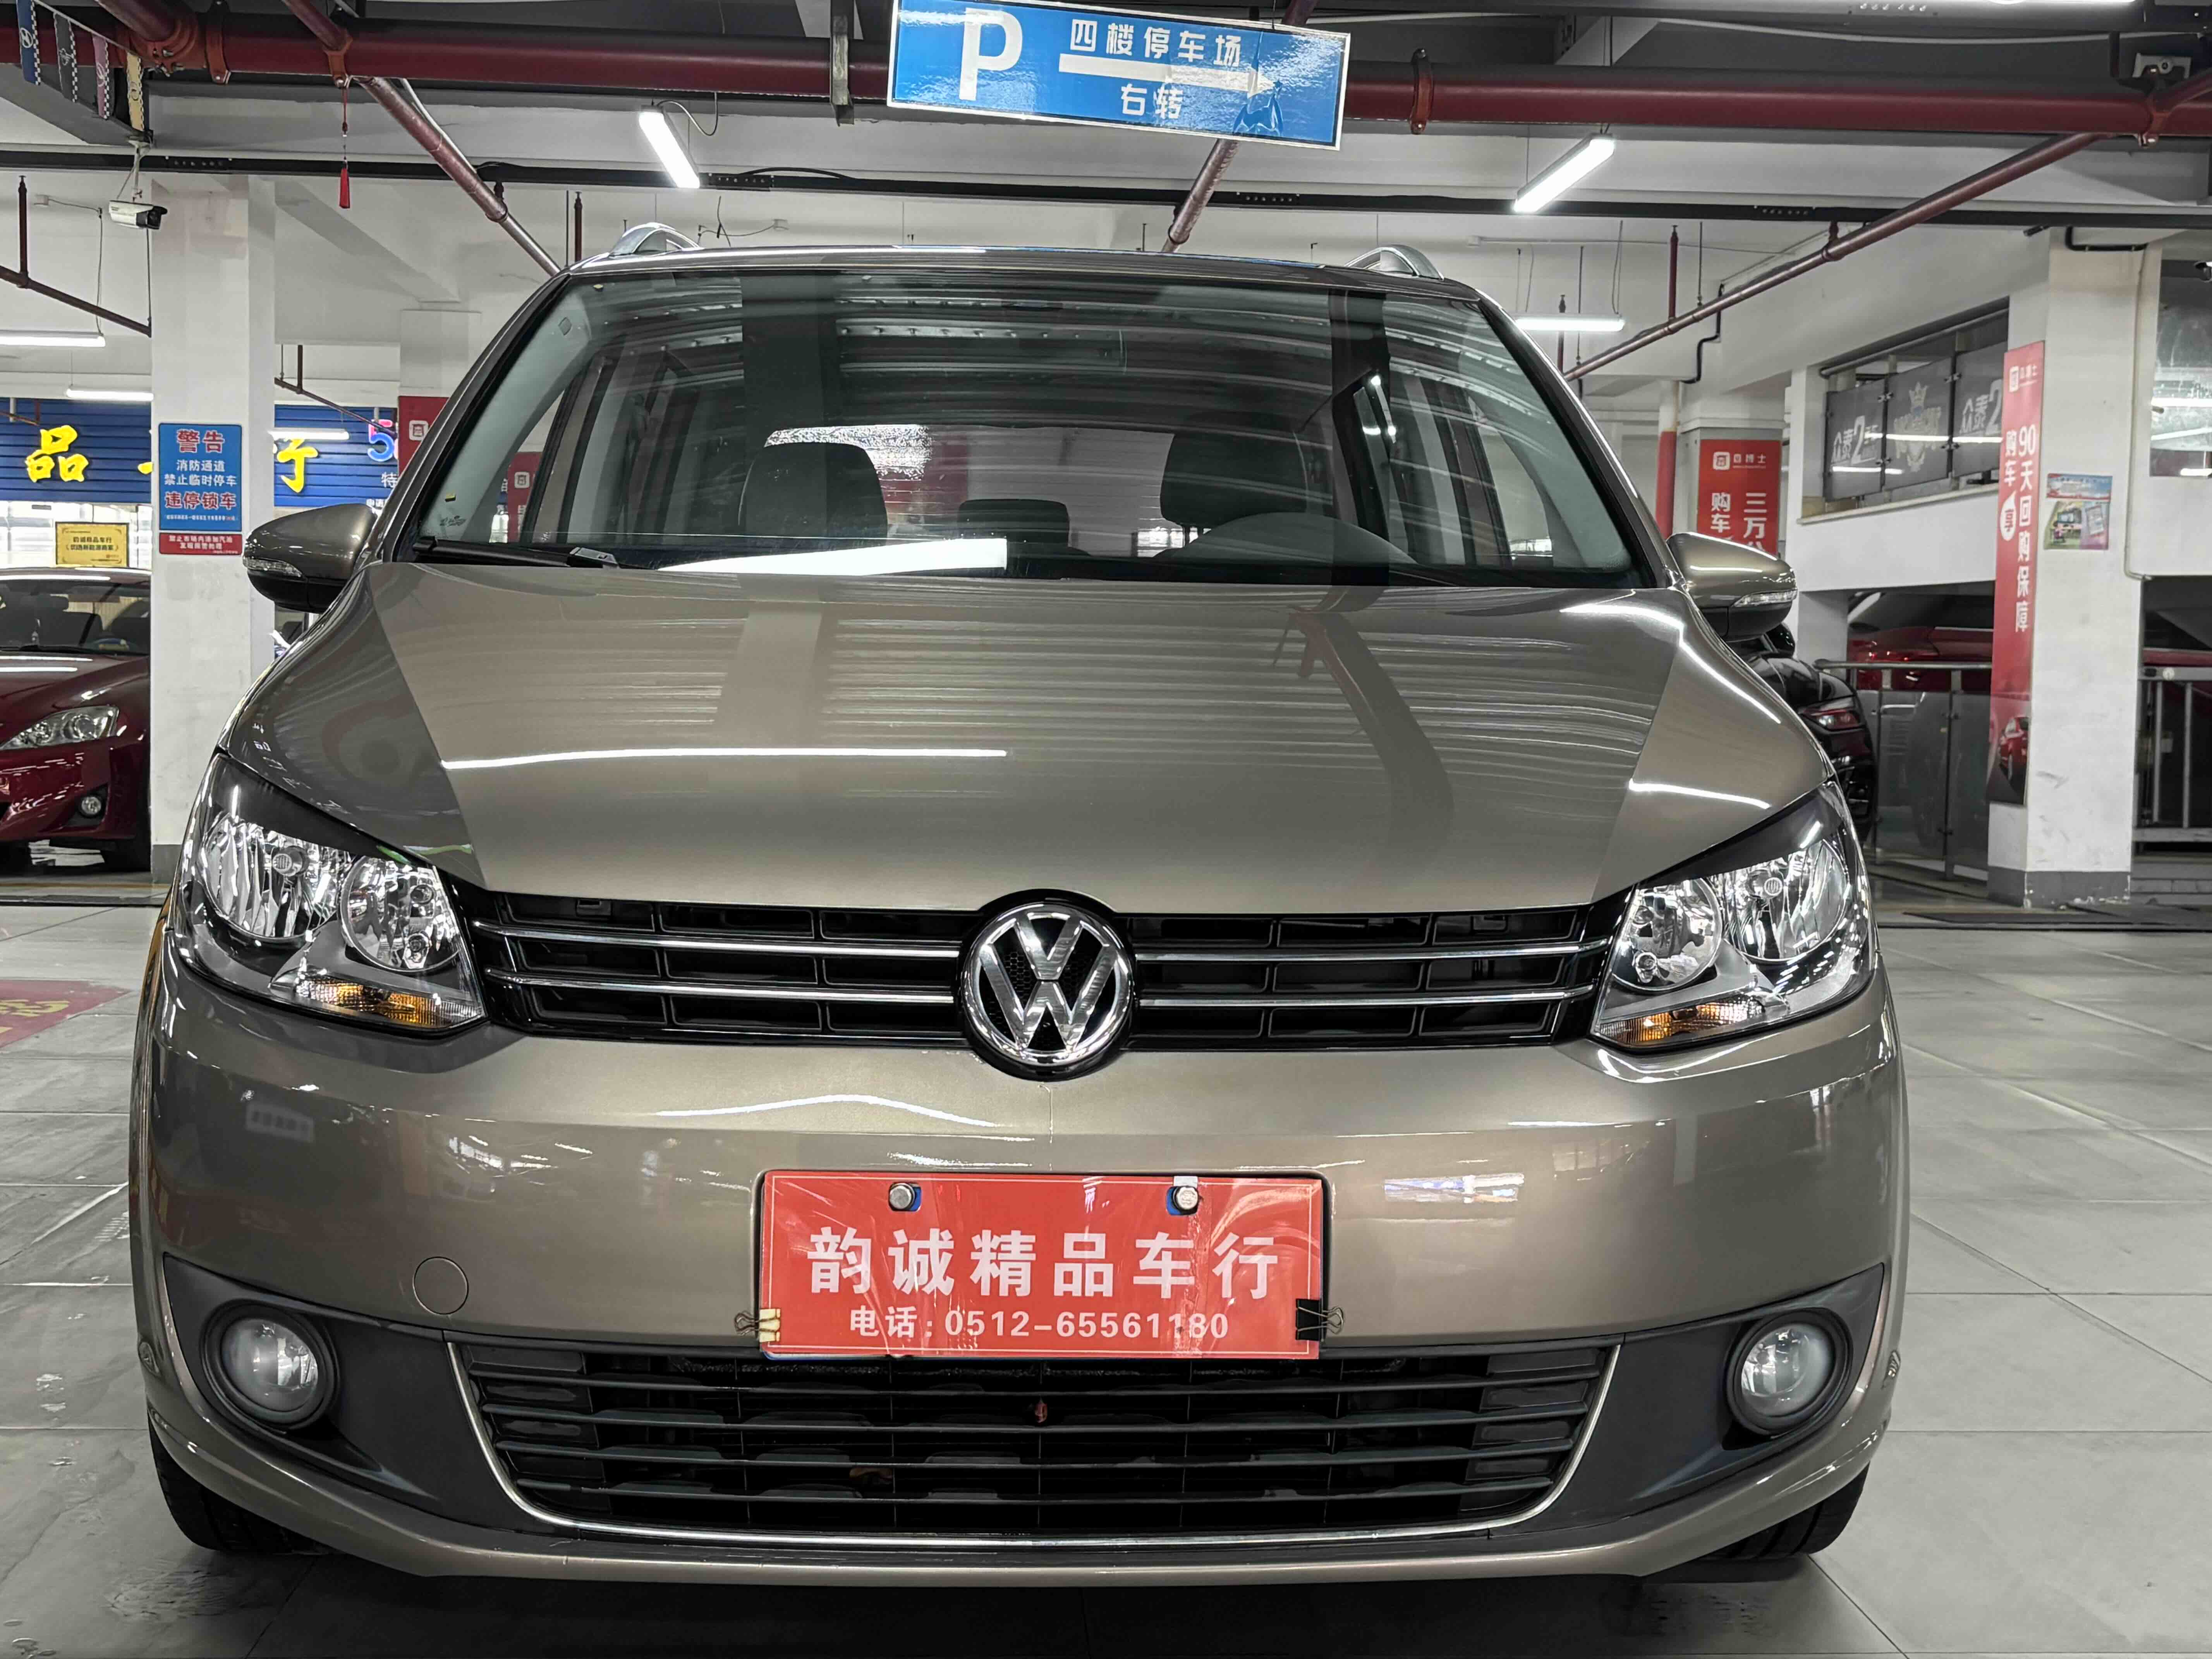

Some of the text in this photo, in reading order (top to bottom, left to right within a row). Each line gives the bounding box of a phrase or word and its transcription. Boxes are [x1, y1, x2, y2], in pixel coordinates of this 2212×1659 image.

[958, 7, 1023, 101] P
[1069, 19, 1243, 66] 四楼停车场
[1120, 82, 1184, 120] 右转
[177, 428, 225, 453] 警告
[164, 473, 237, 487] 禁止临时停车
[177, 459, 225, 472] 消防通道
[165, 490, 237, 511] 违停锁车
[807, 1226, 1278, 1299] 韵诚精品车行
